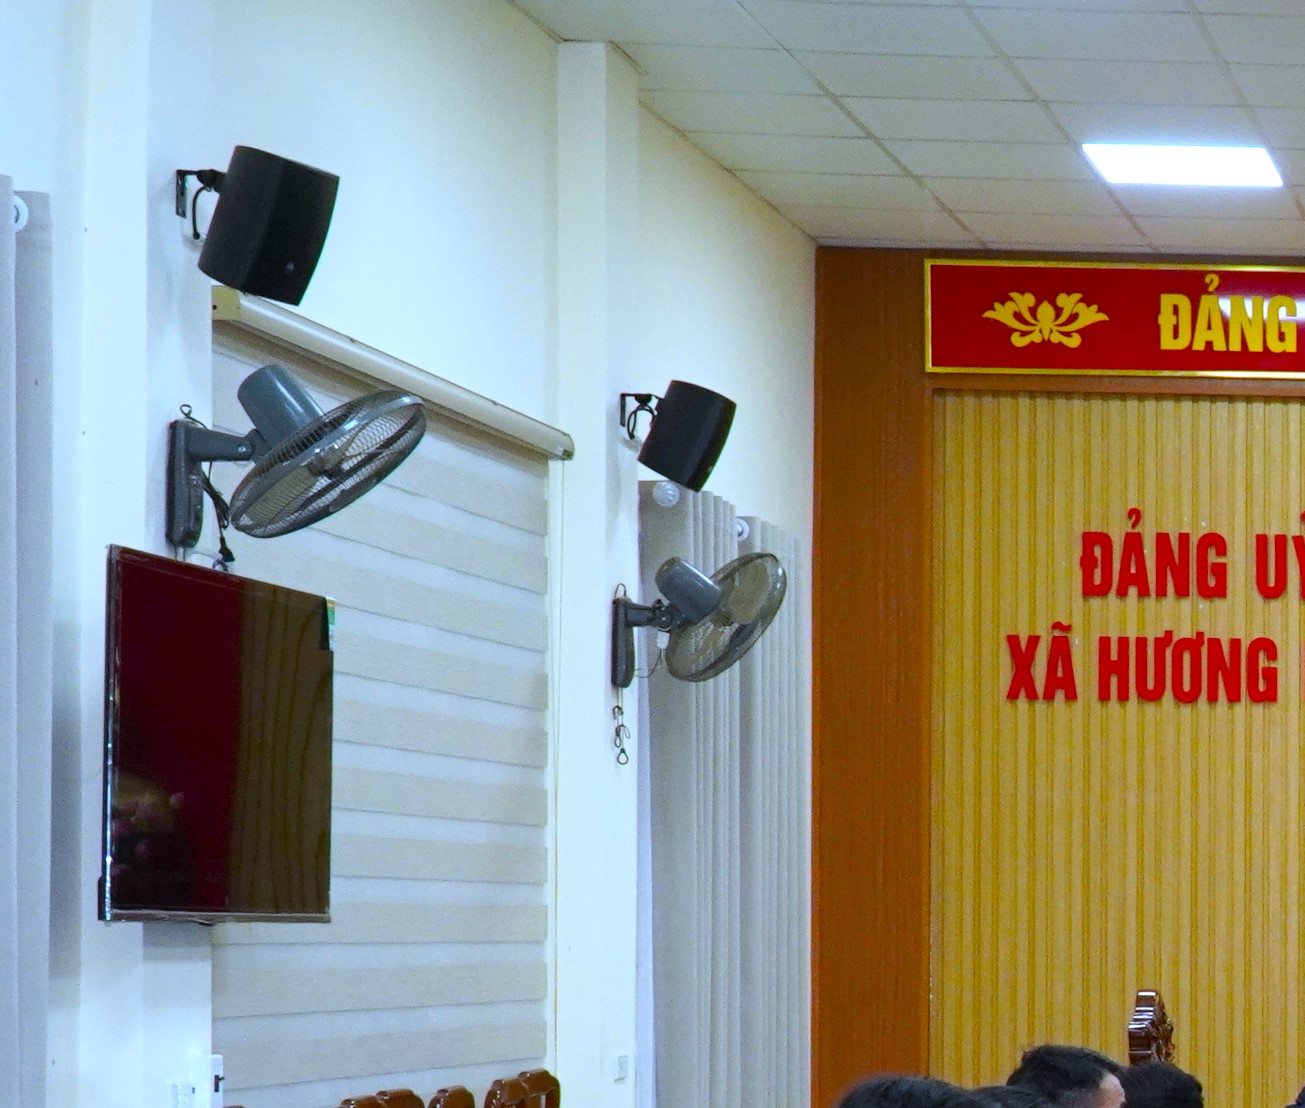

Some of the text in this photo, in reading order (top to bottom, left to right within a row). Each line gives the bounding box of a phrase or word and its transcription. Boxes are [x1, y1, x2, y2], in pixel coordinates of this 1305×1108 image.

[1158, 273, 1298, 353] ĐẢNG
[1081, 508, 1228, 599] ĐẢNG
[1005, 622, 1077, 702] XÃ
[1098, 629, 1278, 704] HƯƠNG
